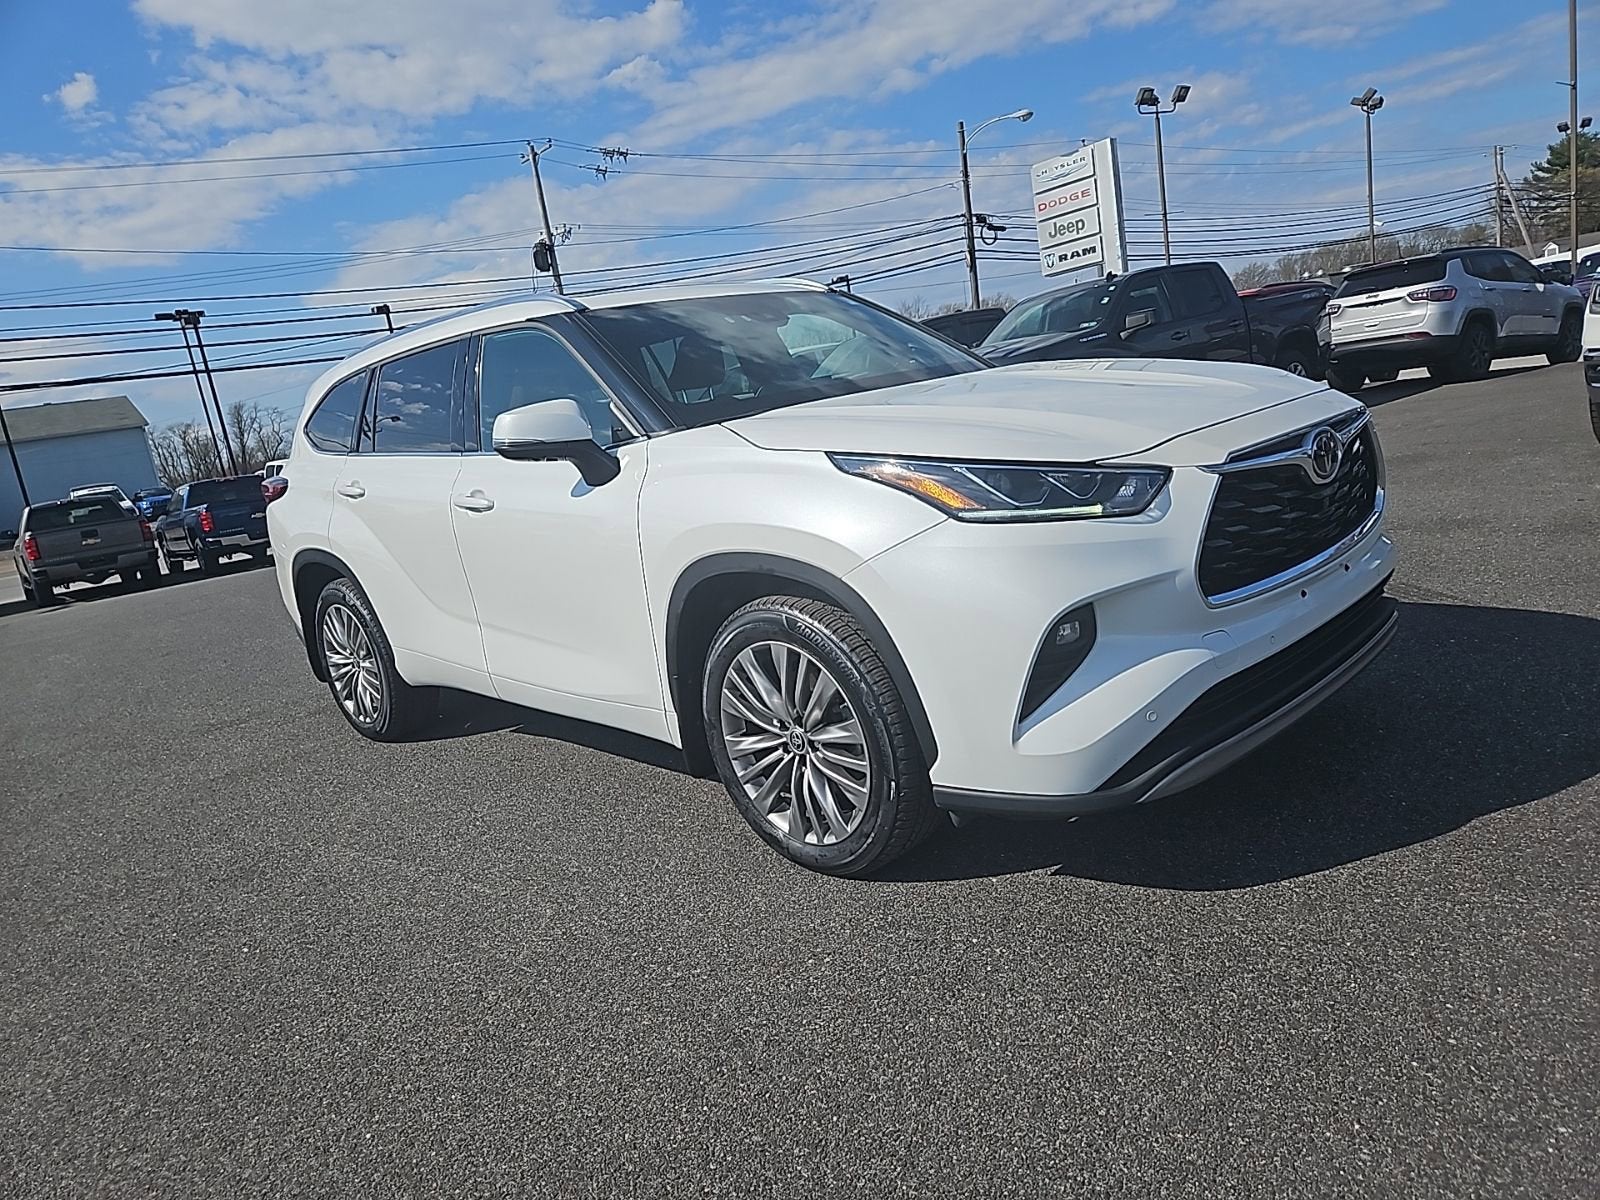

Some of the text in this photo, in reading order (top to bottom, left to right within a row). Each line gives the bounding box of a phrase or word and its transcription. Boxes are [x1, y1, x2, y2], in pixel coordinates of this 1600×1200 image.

[1036, 156, 1086, 178] HYSLER
[1038, 188, 1092, 212] DODGE
[1048, 218, 1086, 239] Jeep
[1058, 245, 1097, 263] RAM
